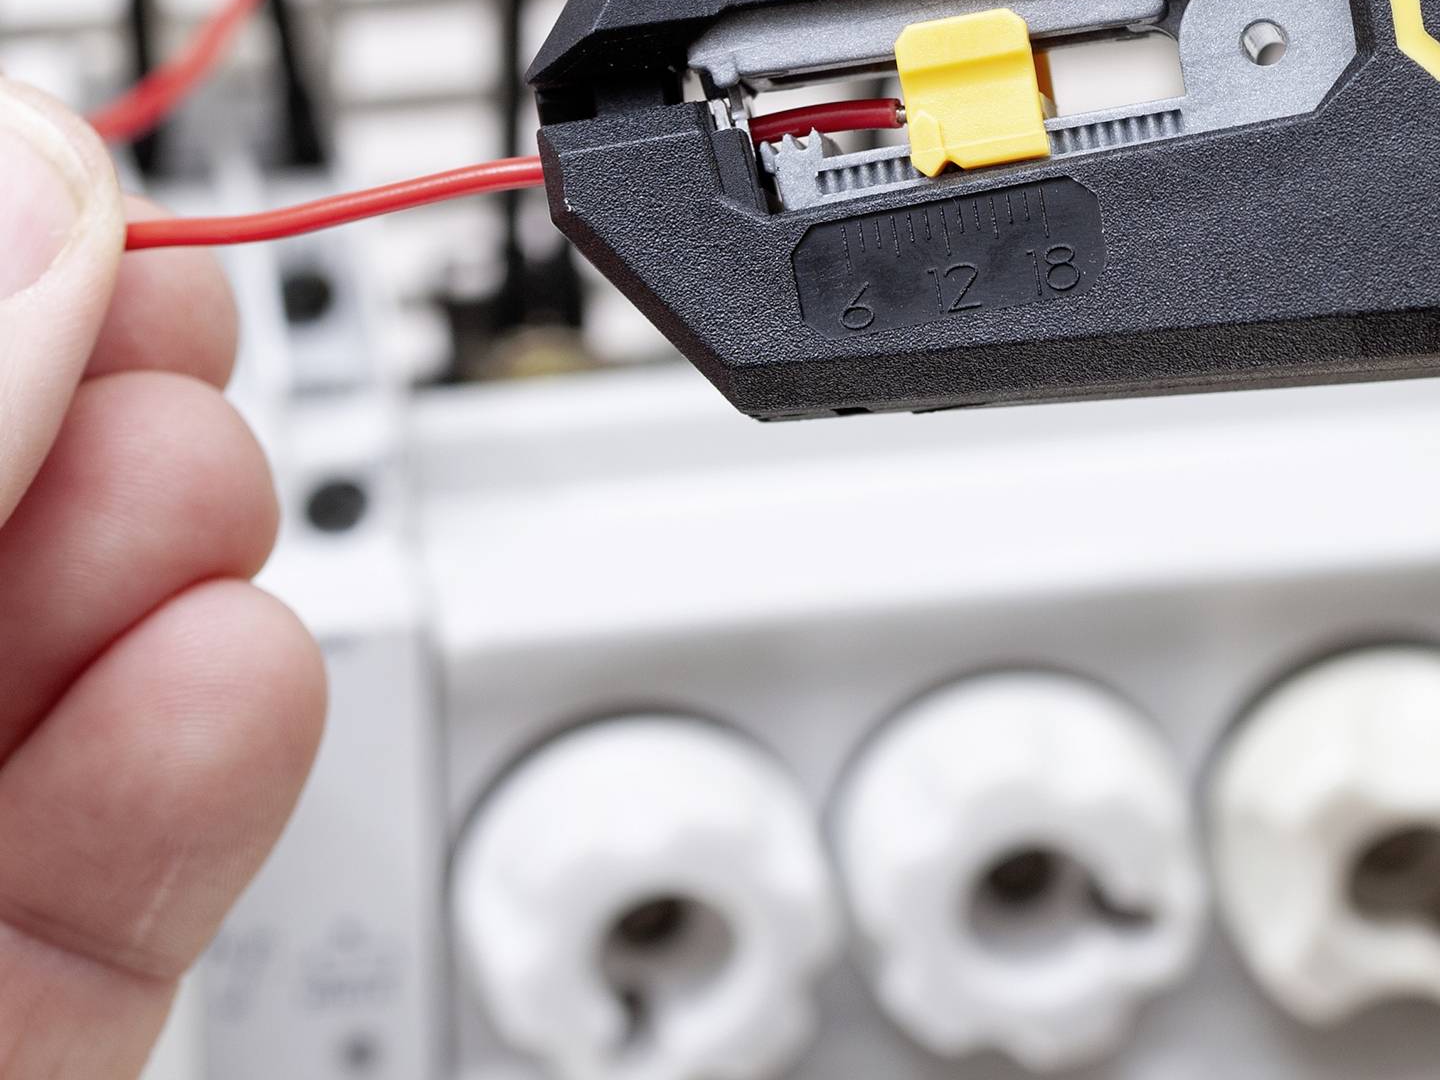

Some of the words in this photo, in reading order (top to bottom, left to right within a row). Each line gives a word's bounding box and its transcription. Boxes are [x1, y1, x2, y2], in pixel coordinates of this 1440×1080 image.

[839, 281, 875, 330] 6
[927, 262, 983, 315] 12
[1026, 244, 1081, 296] 18
